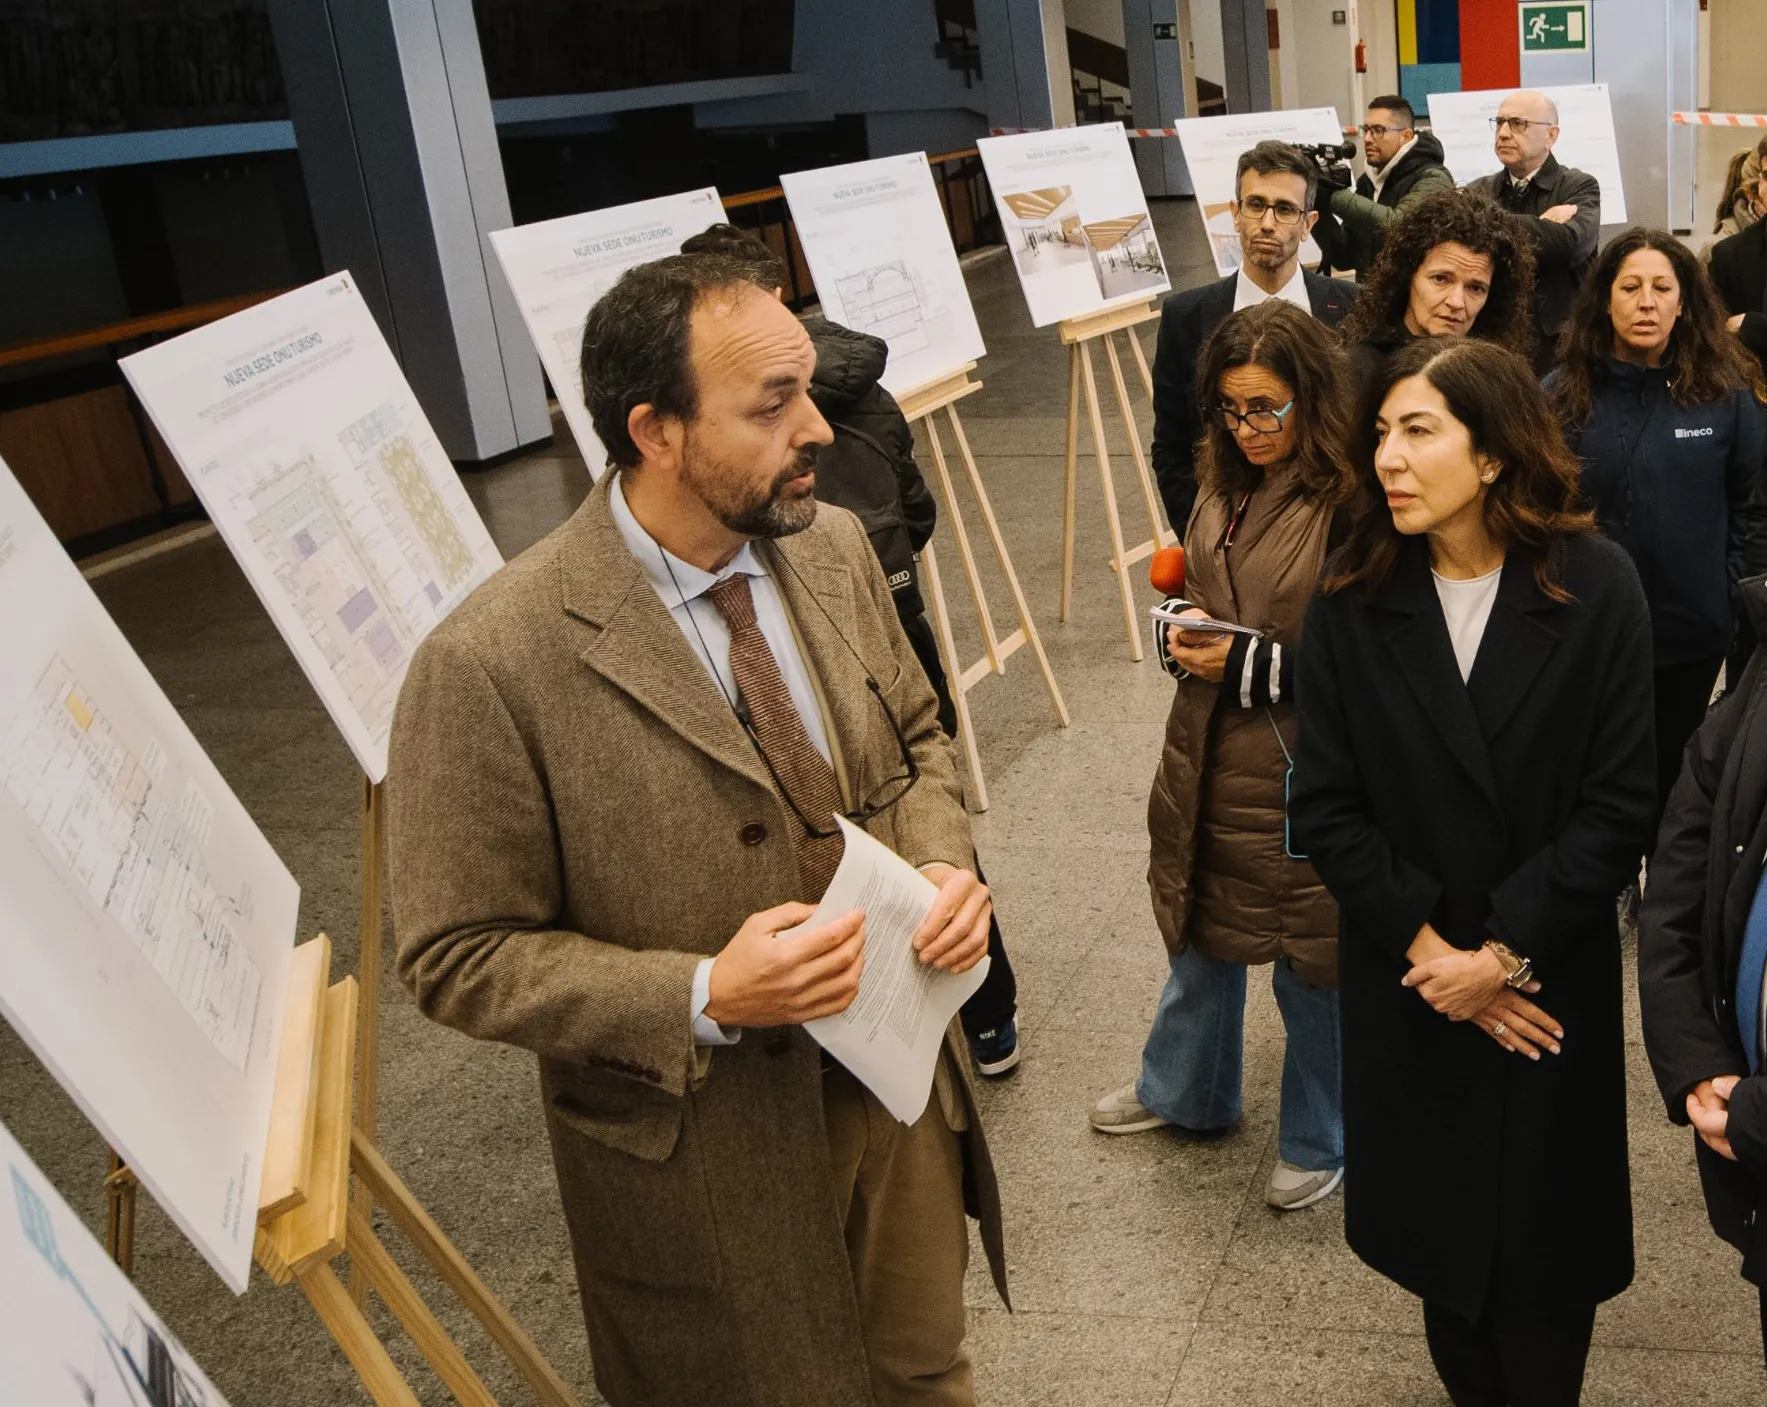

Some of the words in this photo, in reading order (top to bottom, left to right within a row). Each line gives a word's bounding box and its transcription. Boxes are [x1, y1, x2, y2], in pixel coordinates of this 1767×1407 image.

[573, 243, 603, 260] NUEVA
[602, 237, 623, 252] SEDE
[223, 363, 256, 388] NUEVA
[252, 353, 276, 375] SEDE
[1684, 427, 1713, 438] ineco
